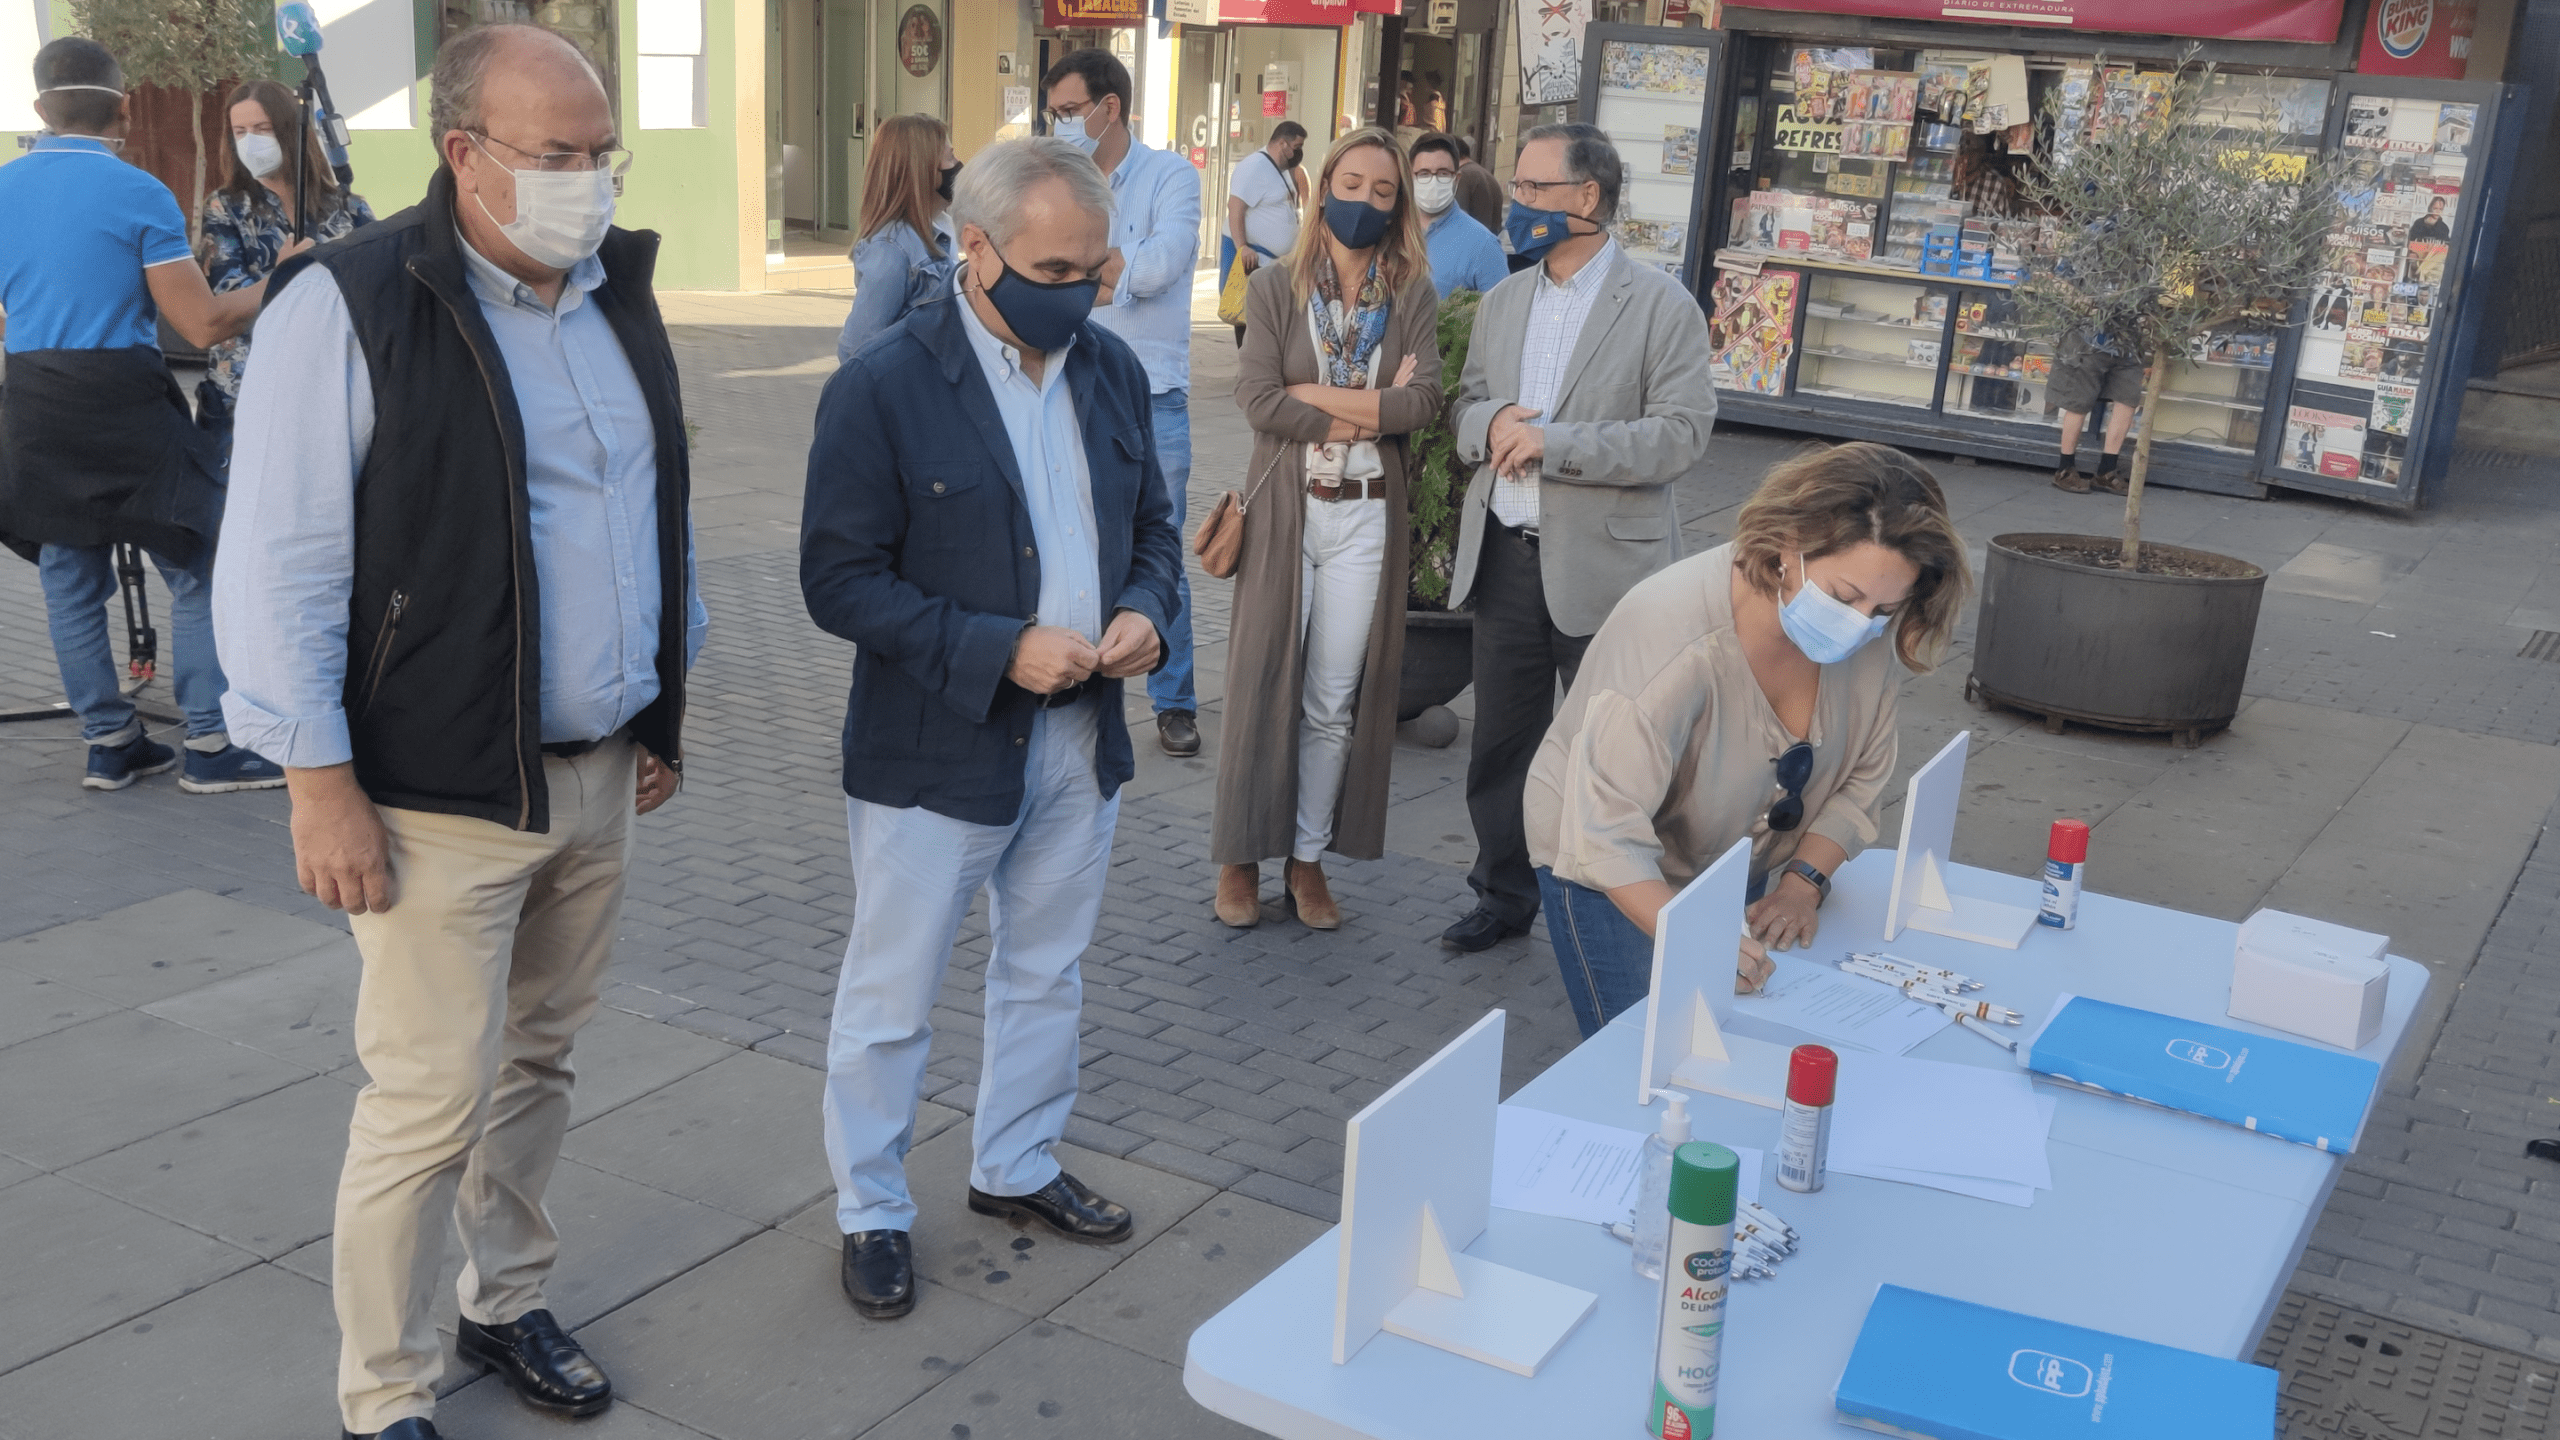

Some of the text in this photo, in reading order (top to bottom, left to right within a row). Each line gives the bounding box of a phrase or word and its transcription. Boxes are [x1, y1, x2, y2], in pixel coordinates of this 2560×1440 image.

[1982, 0, 1995, 8] DE
[1999, 2, 2075, 13] EXTREMADURA
[2385, 5, 2429, 38] KING
[2344, 225, 2385, 238] GUISOS
[2388, 326, 2430, 342] muy
